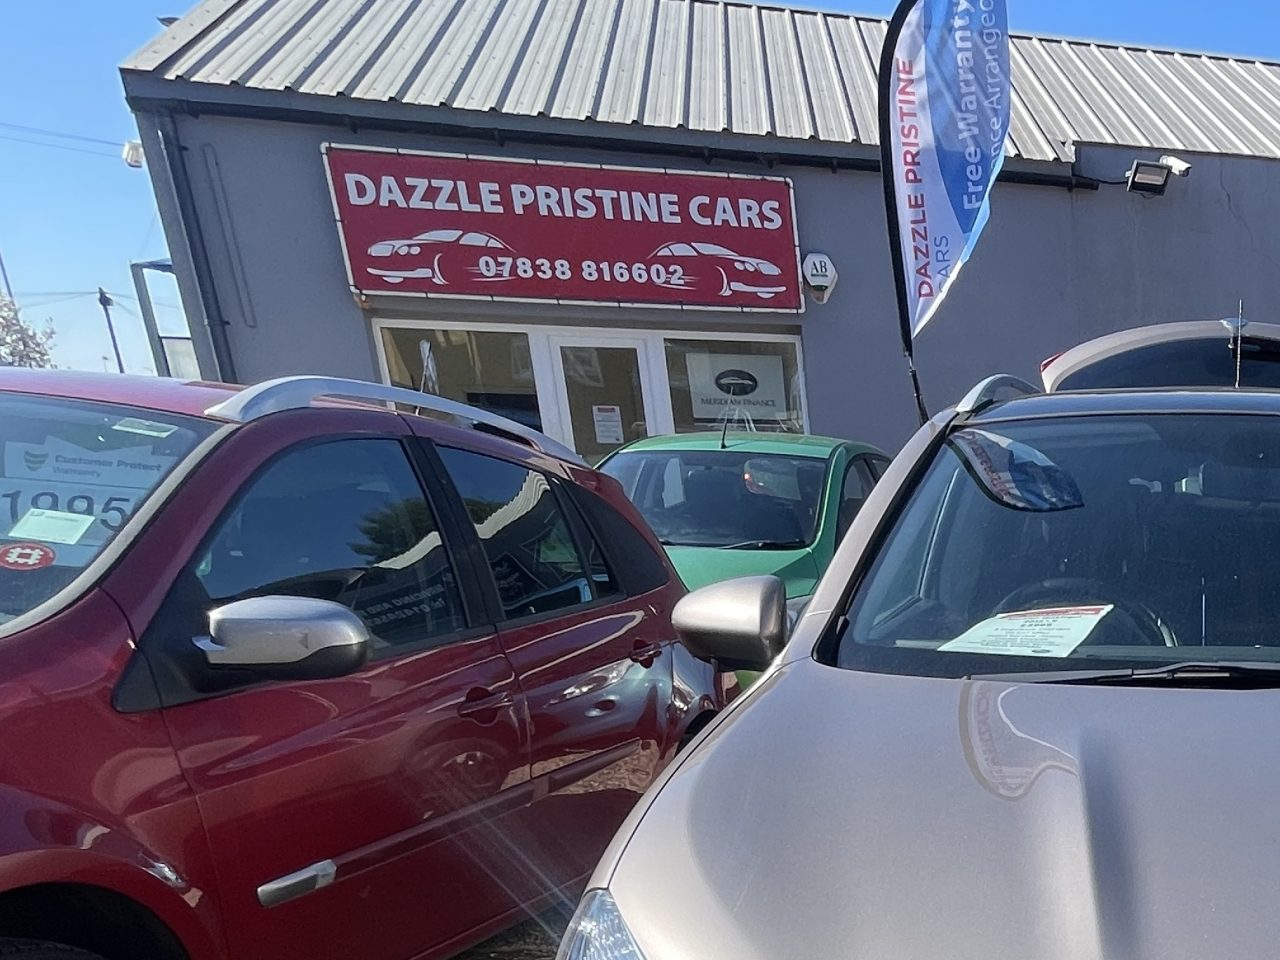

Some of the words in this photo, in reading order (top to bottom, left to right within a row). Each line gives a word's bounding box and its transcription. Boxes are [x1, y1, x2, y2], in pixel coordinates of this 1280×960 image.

[953, 0, 979, 140] Warranty
[896, 57, 922, 184] PRISTINE
[344, 173, 504, 214] DAZZLE
[510, 184, 681, 224] PRISTINE
[688, 195, 783, 231] CARS
[963, 145, 982, 210] Free
[479, 255, 571, 280] 07838
[581, 260, 685, 285] 816602
[908, 194, 934, 298] DAZZLE
[117, 460, 162, 472] Protect
